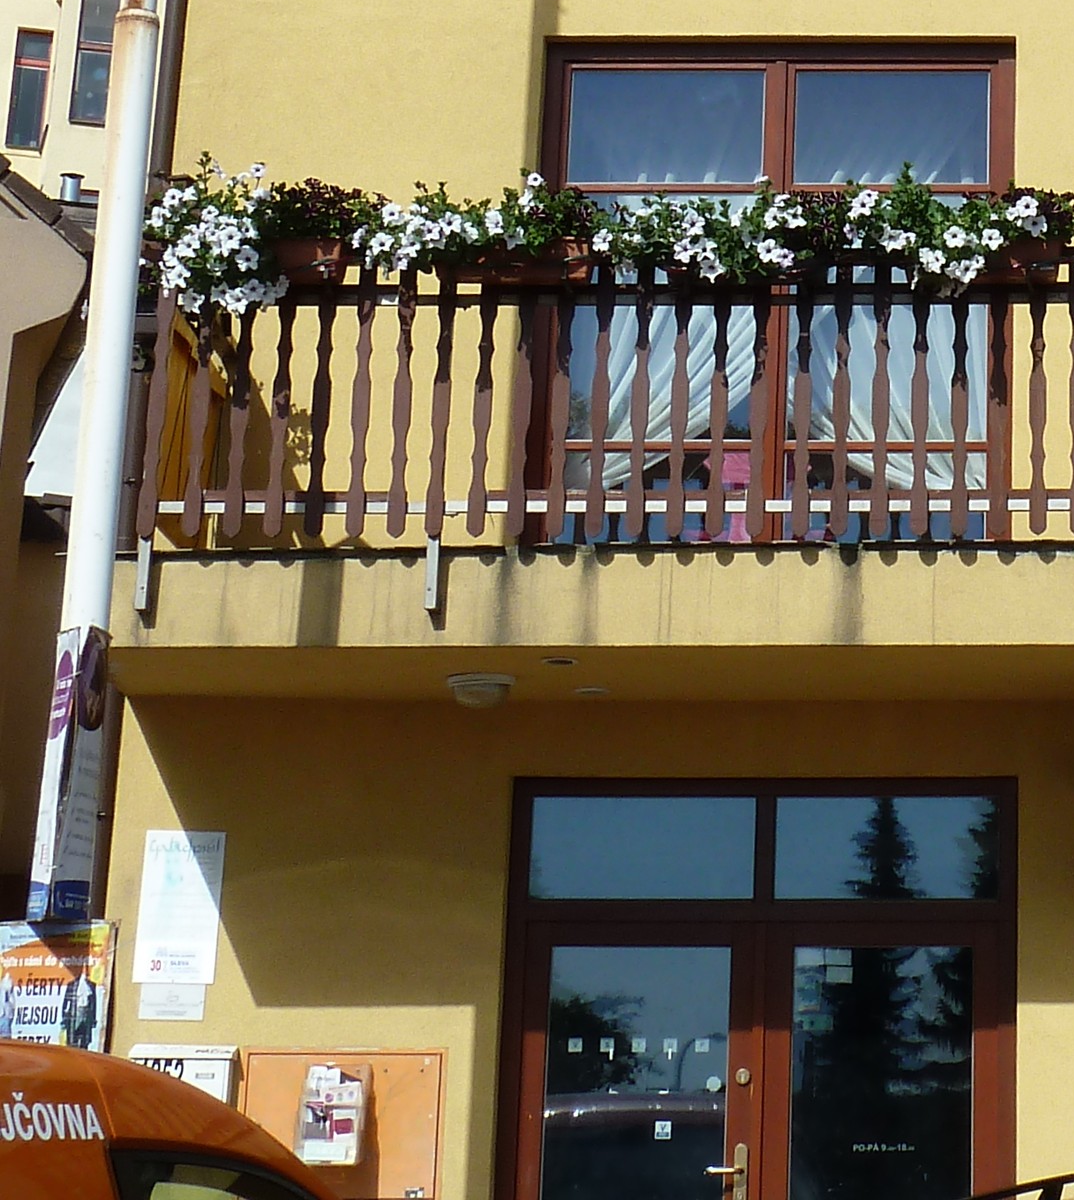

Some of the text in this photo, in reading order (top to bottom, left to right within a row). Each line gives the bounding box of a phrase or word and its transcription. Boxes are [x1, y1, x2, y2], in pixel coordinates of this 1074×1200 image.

[150, 959, 162, 971] 30
[16, 973, 65, 997] S ČERTY
[15, 1005, 59, 1025] NEJSOU
[0, 1091, 105, 1141] JČOVNA
